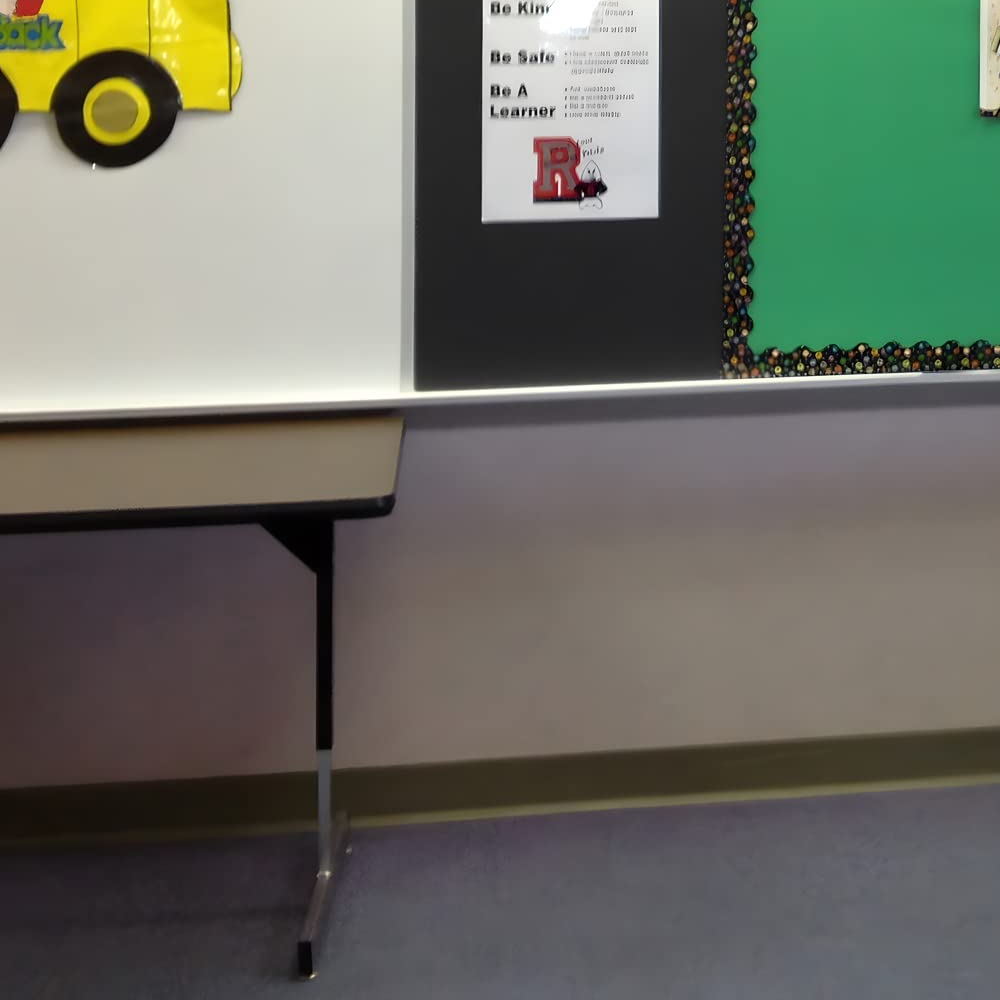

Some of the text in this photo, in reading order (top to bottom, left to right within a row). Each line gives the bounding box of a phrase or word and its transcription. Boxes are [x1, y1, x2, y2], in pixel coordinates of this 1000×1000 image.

[490, 1, 512, 16] Be
[490, 49, 512, 64] Be
[518, 49, 556, 64] Safe
[490, 83, 529, 98] Be A
[490, 103, 557, 118] Learner
